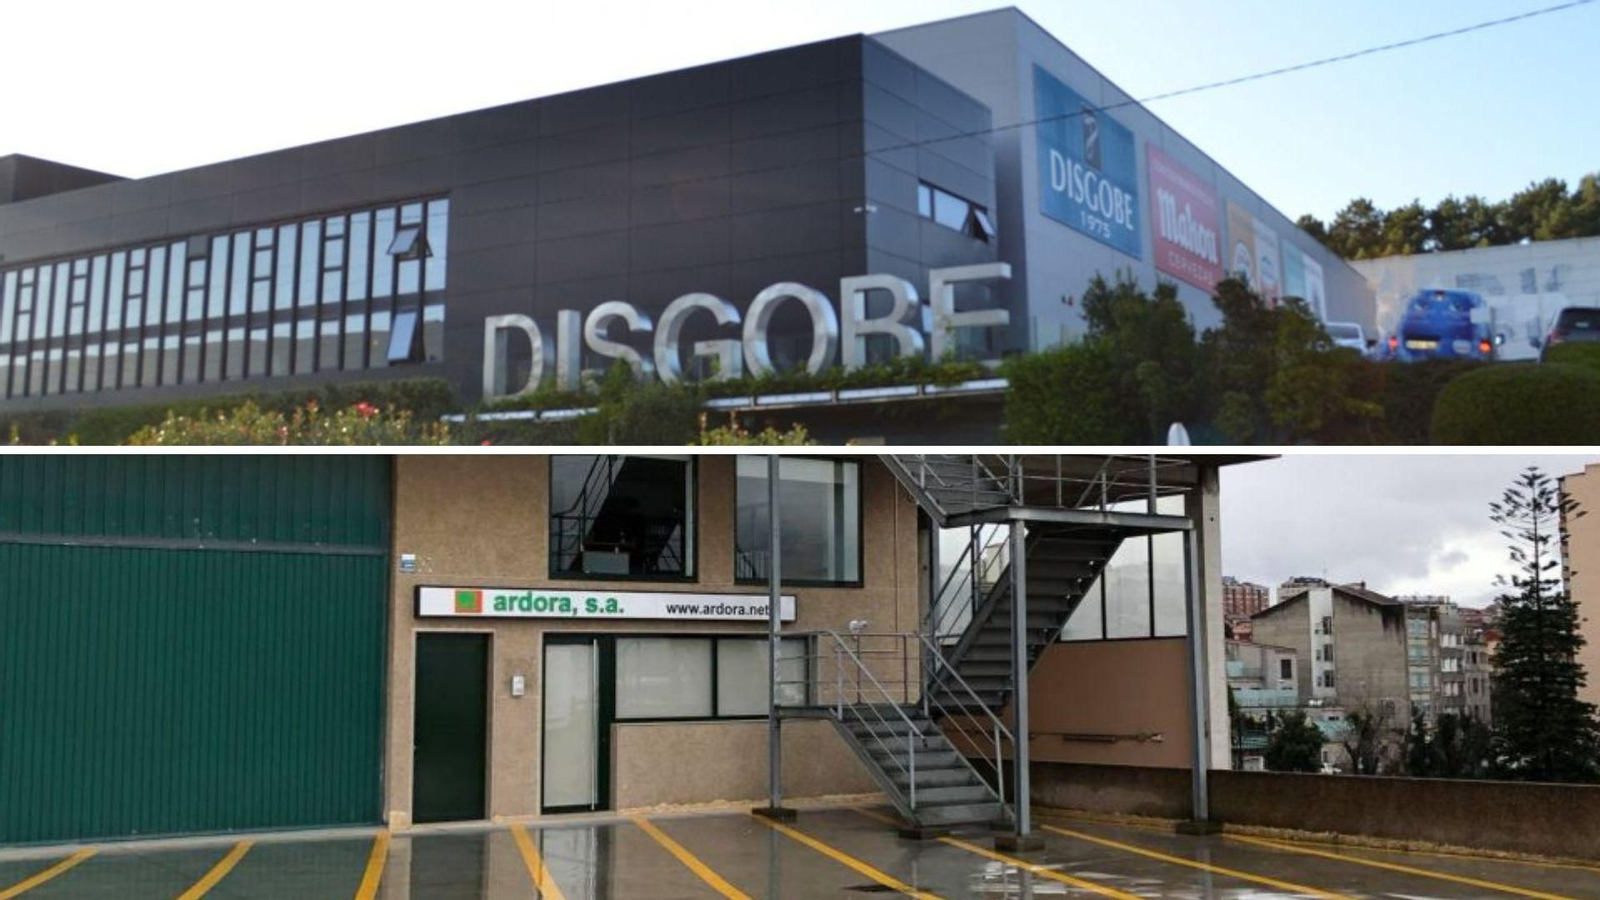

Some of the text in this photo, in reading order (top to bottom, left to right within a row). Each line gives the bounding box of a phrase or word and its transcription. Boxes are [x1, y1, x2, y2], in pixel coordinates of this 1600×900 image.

[1051, 149, 1133, 230] DISGOBE
[1081, 211, 1111, 239] 1975
[483, 262, 1011, 403] DISGOBE
[493, 590, 624, 615] ardora, s.a.
[666, 603, 770, 616] www.ardora.net
